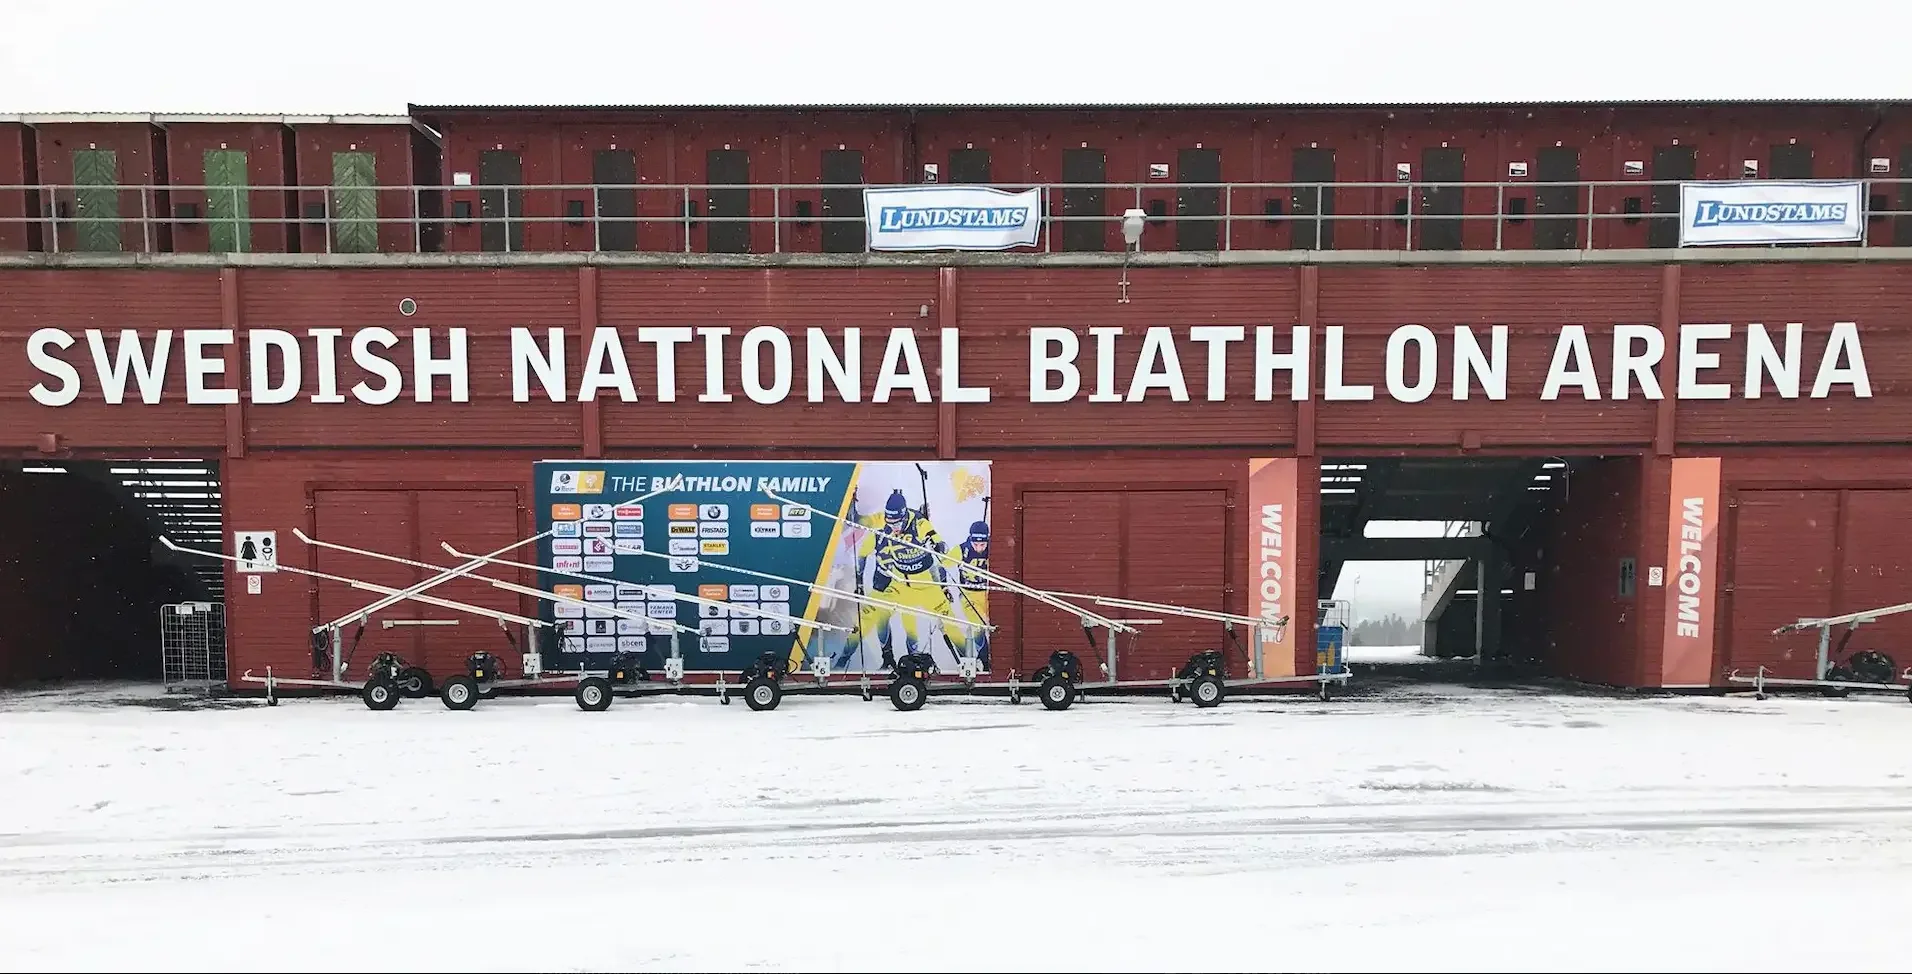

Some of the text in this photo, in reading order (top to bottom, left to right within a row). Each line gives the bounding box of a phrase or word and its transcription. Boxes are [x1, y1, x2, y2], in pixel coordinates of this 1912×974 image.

[881, 207, 1027, 230] LUNDSTAMS
[1697, 202, 1846, 224] LUNDSTAMS
[27, 322, 1872, 406] SWEDISH NATIONAL BIATHLON ARENA
[611, 476, 831, 492] THE BIATHLON FAMILY
[1260, 503, 1283, 643] WELCOME
[1677, 497, 1704, 638] WELCOME
[671, 669, 678, 678] 9
[819, 667, 826, 676] 6
[964, 669, 972, 678] 8
